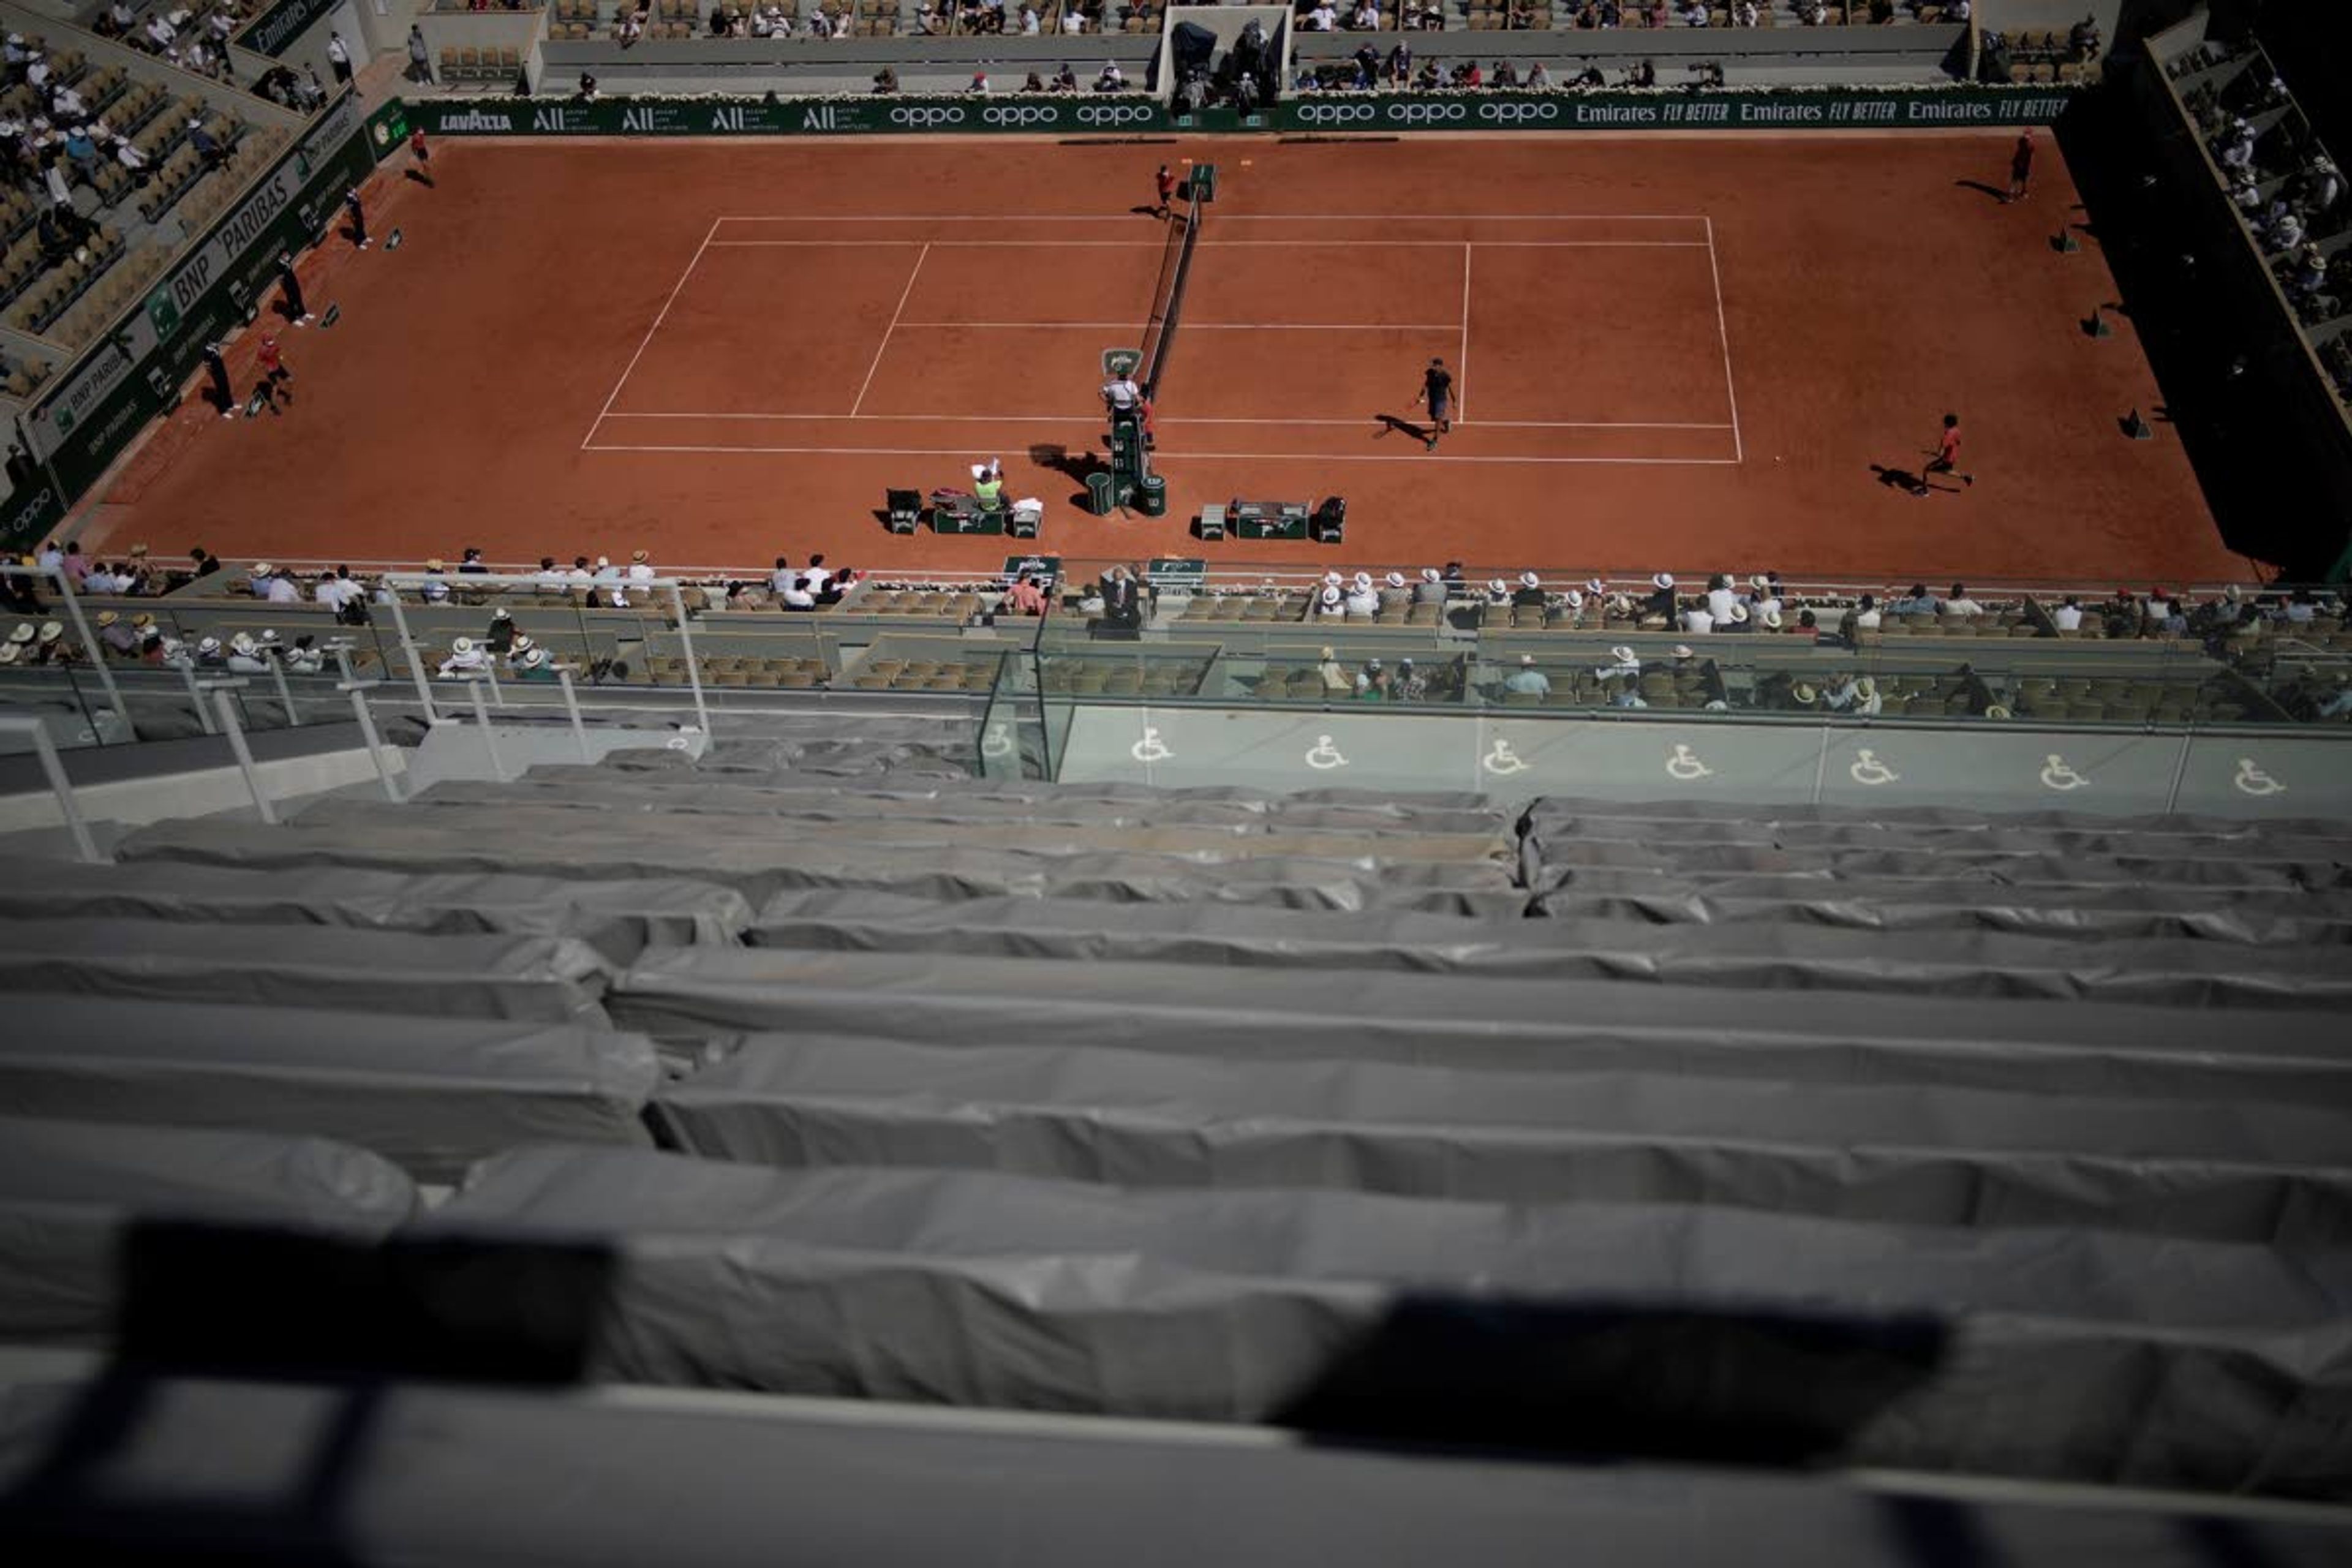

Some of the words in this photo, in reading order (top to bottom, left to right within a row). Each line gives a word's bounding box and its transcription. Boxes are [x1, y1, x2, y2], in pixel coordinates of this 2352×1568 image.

[440, 109, 512, 130] LAVAZZA
[891, 107, 965, 127] oppo
[983, 107, 1058, 127] oppo
[1076, 105, 1153, 127] oppo
[1297, 104, 1376, 125] oppo
[1387, 103, 1466, 125] oppo
[1479, 103, 1558, 125] oppo
[1577, 104, 1656, 123] Emirates
[1663, 104, 1682, 122] FLY
[1685, 104, 1730, 121] BETTER
[1741, 103, 1822, 121] Emirates
[1828, 102, 1849, 121] FLY
[1852, 102, 1898, 120] BETTER
[1909, 101, 1992, 119] Emirates
[1999, 100, 2022, 119] FLY
[175, 255, 209, 309] BNP
[223, 176, 288, 258] PARIBAS
[70, 380, 92, 410] BNP
[13, 488, 51, 532] oppo
